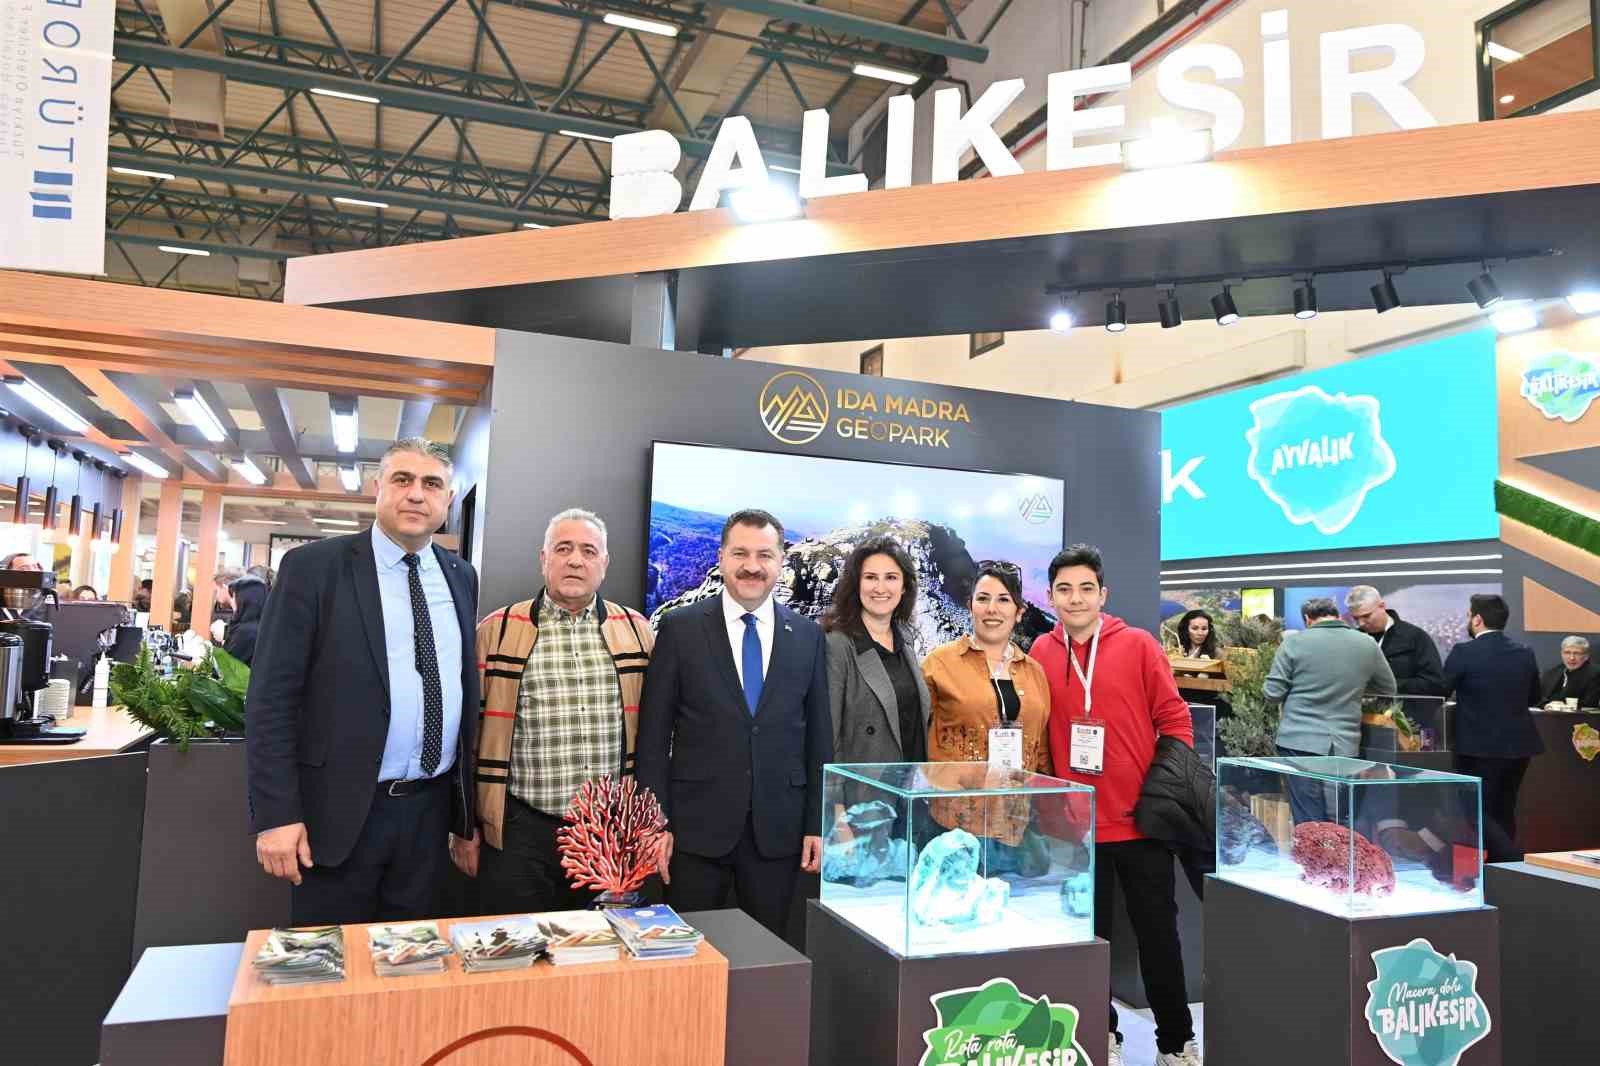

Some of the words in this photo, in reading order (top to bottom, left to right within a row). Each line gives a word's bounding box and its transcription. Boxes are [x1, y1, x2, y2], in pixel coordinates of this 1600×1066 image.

[609, 9, 1437, 220] BALIKESİR
[836, 388, 877, 412] IDA
[884, 394, 971, 423] MADRA
[836, 417, 951, 448] GEOPARK
[1270, 432, 1355, 475] AYVALIK
[1387, 981, 1437, 1008] Macera
[1439, 976, 1464, 995] dolu
[1376, 994, 1481, 1040] BALIKESİR
[944, 1029, 983, 1062] Rota
[987, 1029, 1018, 1056] rota
